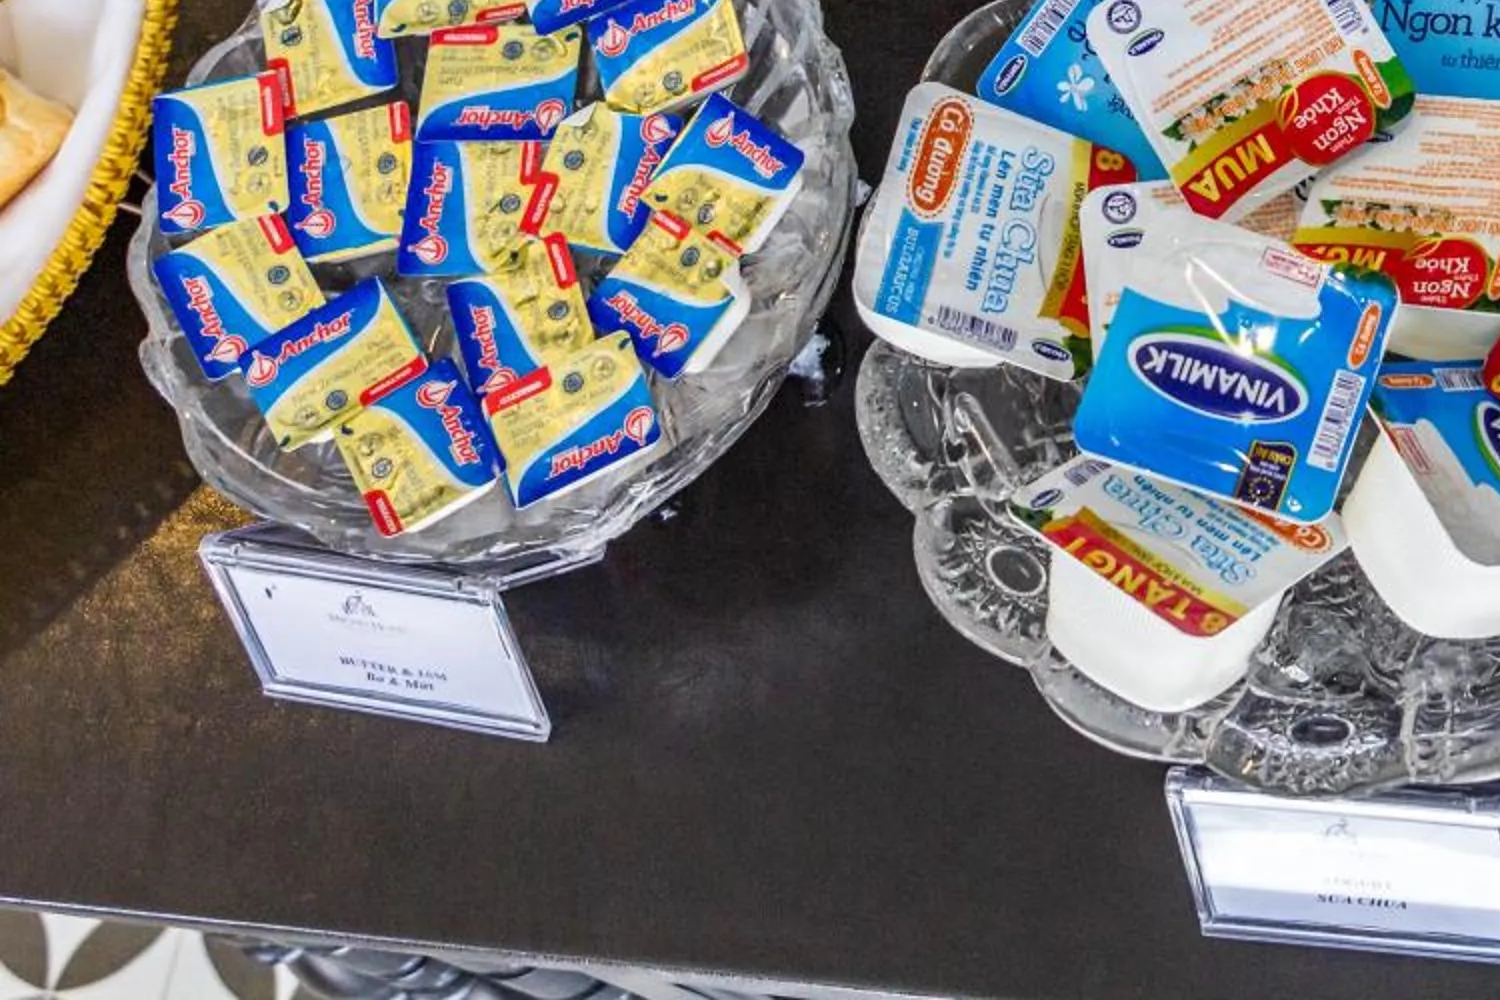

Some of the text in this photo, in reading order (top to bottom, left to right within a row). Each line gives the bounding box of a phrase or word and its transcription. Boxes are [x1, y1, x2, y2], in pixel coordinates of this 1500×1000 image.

[455, 105, 539, 129] Anchor
[939, 107, 964, 133] Có
[1293, 88, 1344, 129] Khỏe
[1312, 108, 1367, 150] Ngon
[170, 127, 194, 198] Anchor
[302, 140, 323, 207] Anchor
[726, 125, 789, 178] Anchor
[915, 137, 953, 204] đường
[995, 150, 1016, 179] Lên
[1095, 152, 1125, 172] 8
[1186, 135, 1276, 204] MUA
[419, 162, 454, 236] Anchor
[616, 147, 662, 223] Anchor
[986, 184, 1004, 218] men
[1012, 144, 1056, 212] Sữa
[976, 223, 995, 241] tự
[965, 250, 988, 291] nhiên
[980, 220, 1036, 314] Chua
[1415, 257, 1470, 274] Khỏe
[185, 277, 225, 344] Anchor
[1413, 282, 1471, 299] Ngon
[277, 311, 354, 362] Anchor
[472, 306, 501, 373] Anchor
[606, 291, 662, 346] Anchor
[1144, 345, 1287, 413] VINAMILK
[437, 400, 482, 466] Anchor
[551, 431, 621, 478] Anchor
[1103, 474, 1187, 538] Chua
[1134, 475, 1173, 506] nhiên
[1198, 519, 1229, 542] men
[1232, 540, 1262, 561] Lên
[1190, 535, 1255, 585] Sữa
[1202, 613, 1227, 631] 8
[1357, 896, 1407, 910] CHUA
